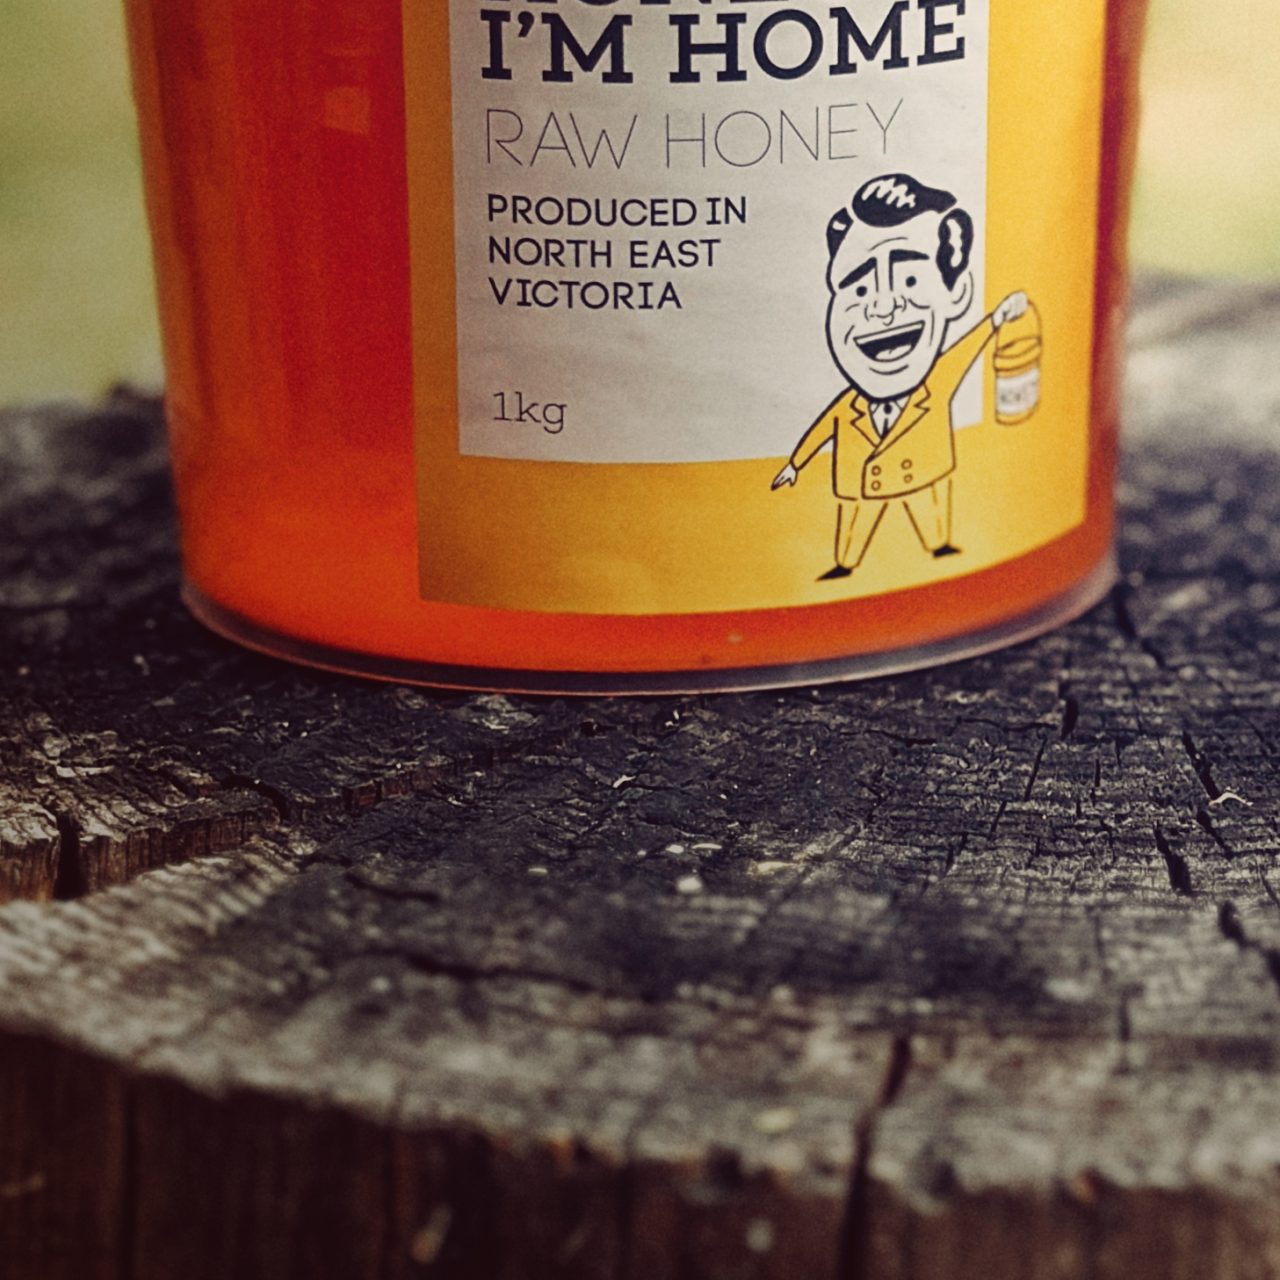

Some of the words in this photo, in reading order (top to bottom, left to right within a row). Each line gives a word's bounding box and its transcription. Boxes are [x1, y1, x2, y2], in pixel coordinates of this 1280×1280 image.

[480, 10, 634, 84] I'M
[485, 108, 638, 169] RAW
[665, 98, 904, 168] HONEY
[487, 193, 698, 227] PRODUCED
[705, 196, 747, 225] IN
[488, 236, 612, 269] NORTH
[630, 239, 721, 269] EAST
[488, 277, 683, 310] VICTORIA
[492, 391, 568, 434] 1kg
